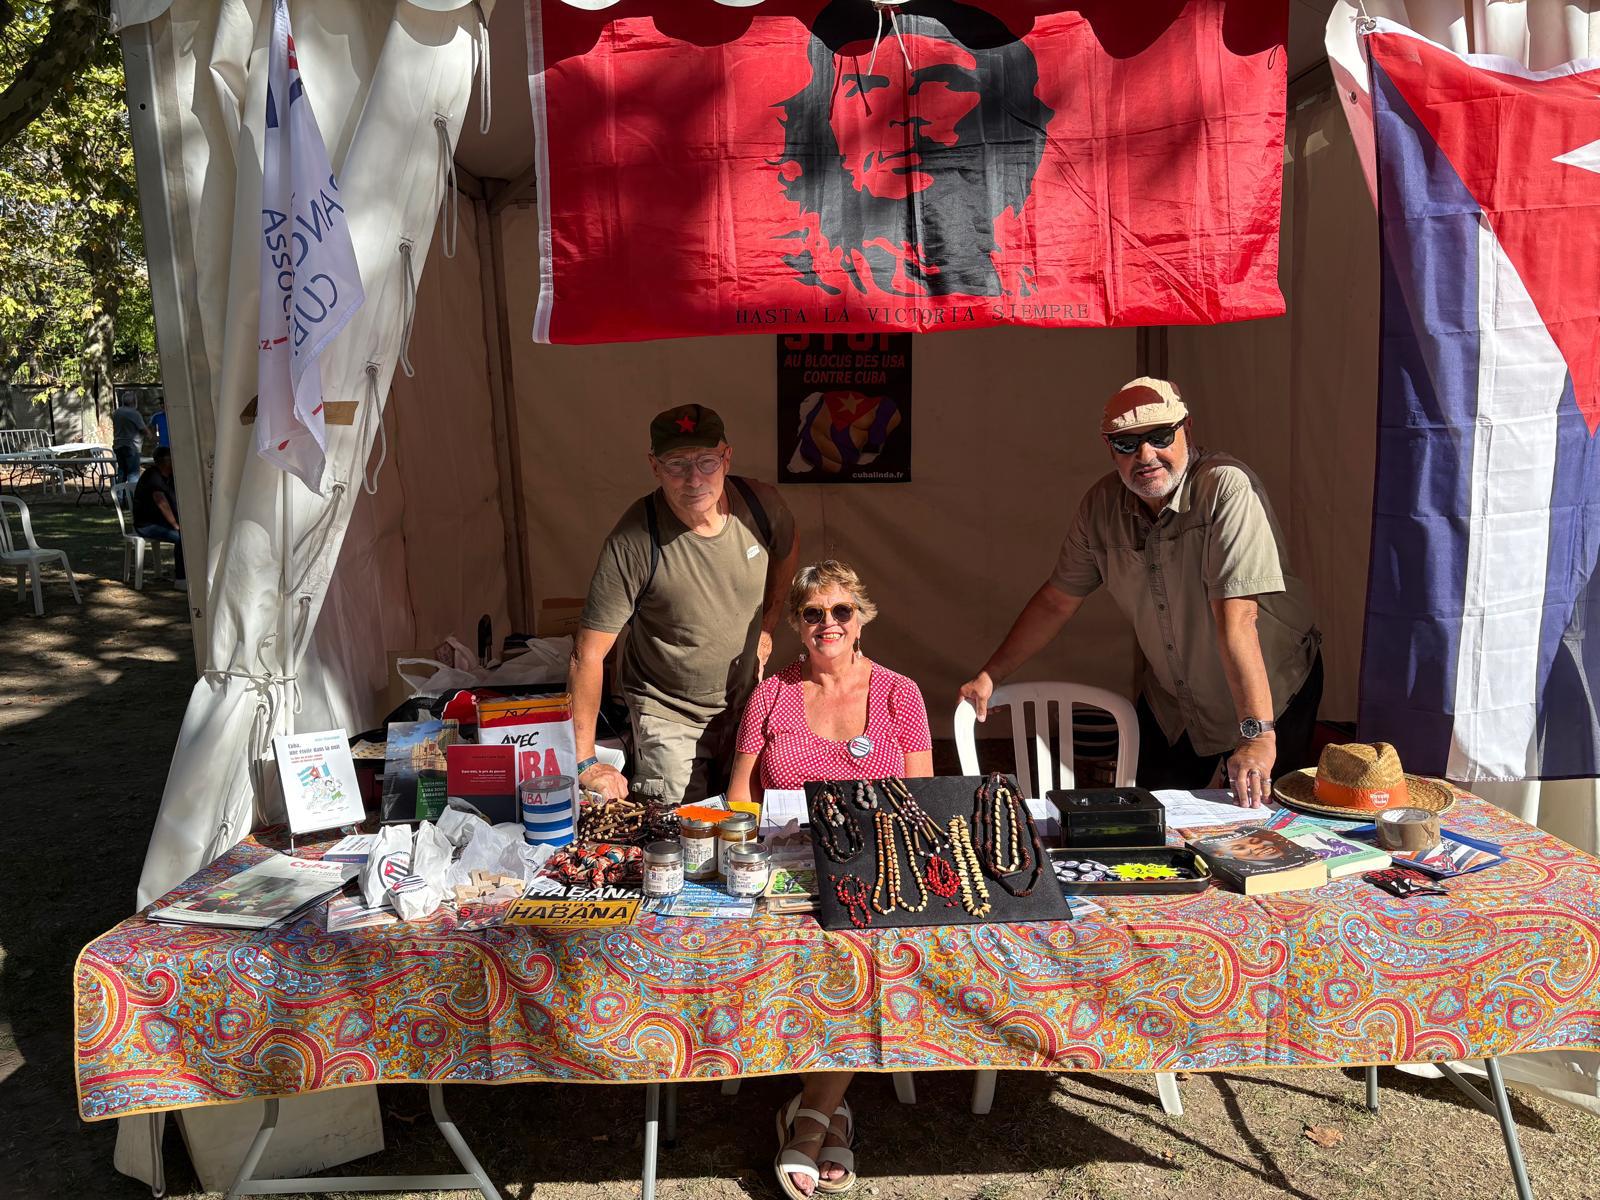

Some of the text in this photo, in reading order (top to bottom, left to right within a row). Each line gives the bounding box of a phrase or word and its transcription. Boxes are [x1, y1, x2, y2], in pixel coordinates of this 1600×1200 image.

[736, 303, 1089, 325] HASTA LA VICTORIA SIEMPRE
[784, 354, 905, 368] AU BLOCUS DES USA
[803, 370, 887, 384] CONTRE CUBA
[852, 470, 904, 479] cubalinda.fr
[501, 731, 539, 748] AVEC
[507, 906, 628, 919] HABANA
